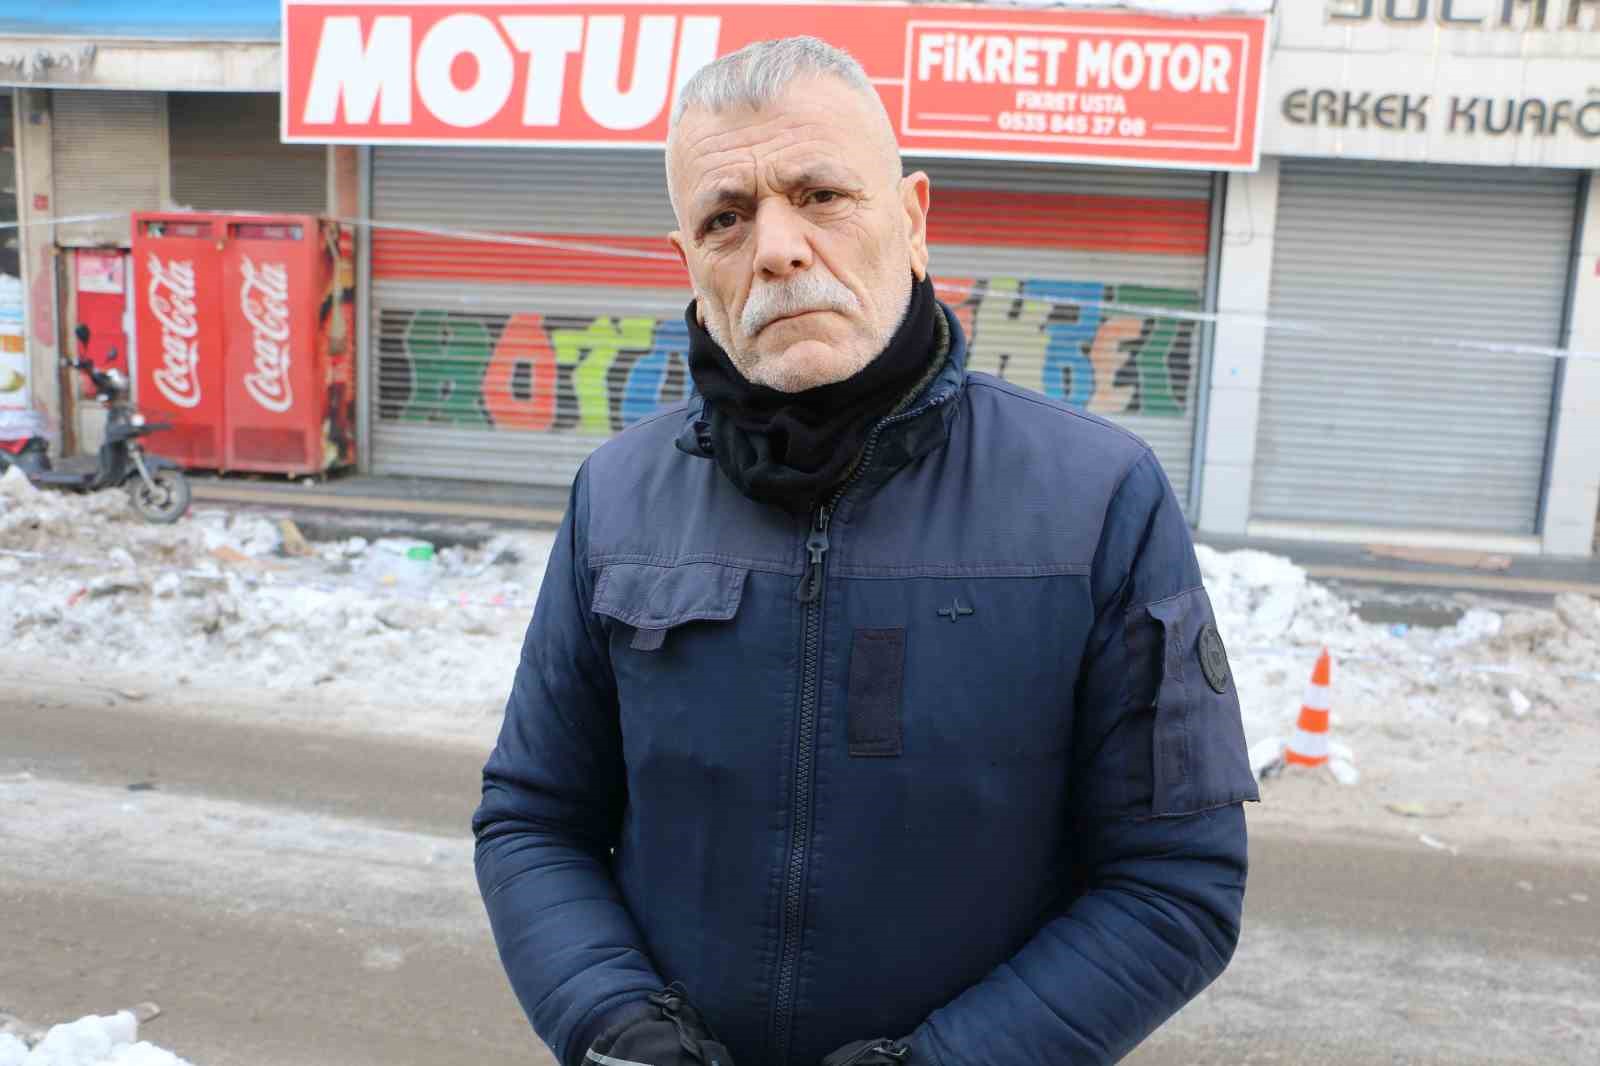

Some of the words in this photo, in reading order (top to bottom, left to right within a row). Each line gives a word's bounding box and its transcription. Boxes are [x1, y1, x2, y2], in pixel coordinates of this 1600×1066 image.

[1076, 41, 1231, 93] MOTOR
[1080, 93, 1127, 113] USTA
[1282, 89, 1428, 132] ERKEK
[1091, 116, 1116, 135] 37
